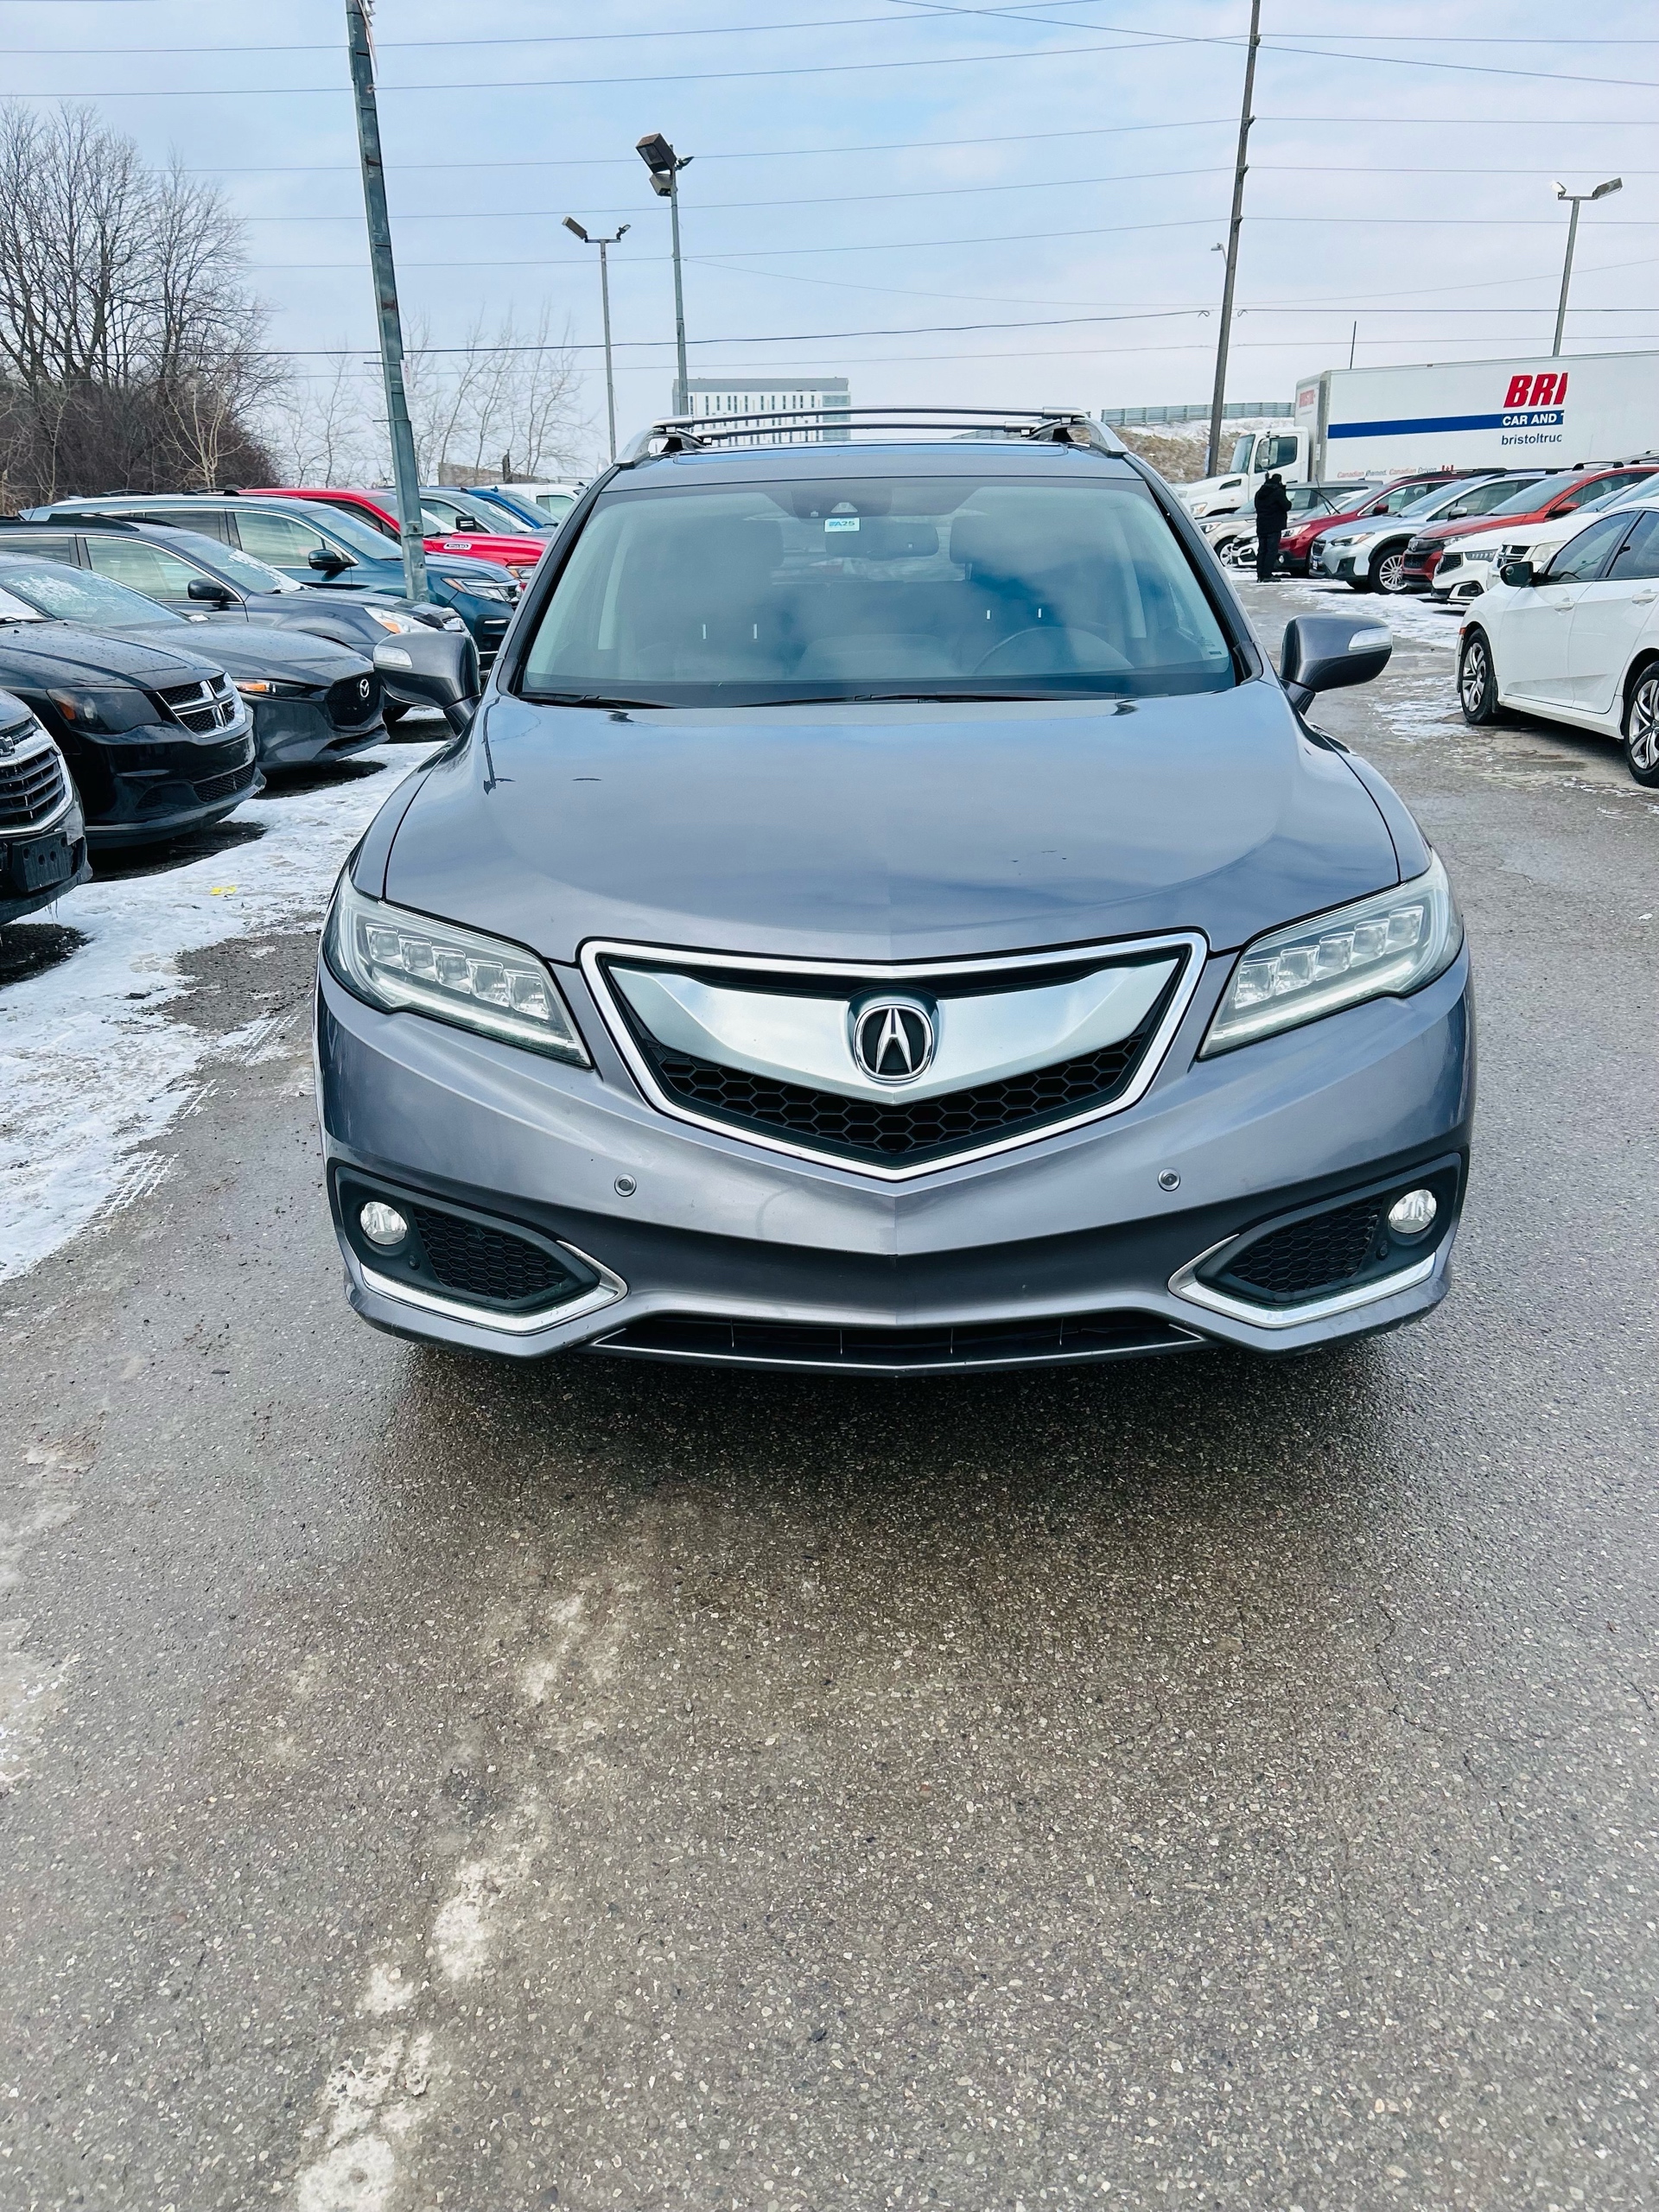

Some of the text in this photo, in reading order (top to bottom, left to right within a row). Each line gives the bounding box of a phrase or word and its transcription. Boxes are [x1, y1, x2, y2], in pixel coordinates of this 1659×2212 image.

[1502, 415, 1529, 427] CAR
[1530, 413, 1558, 425] AND
[1501, 432, 1563, 446] bristoltruc
